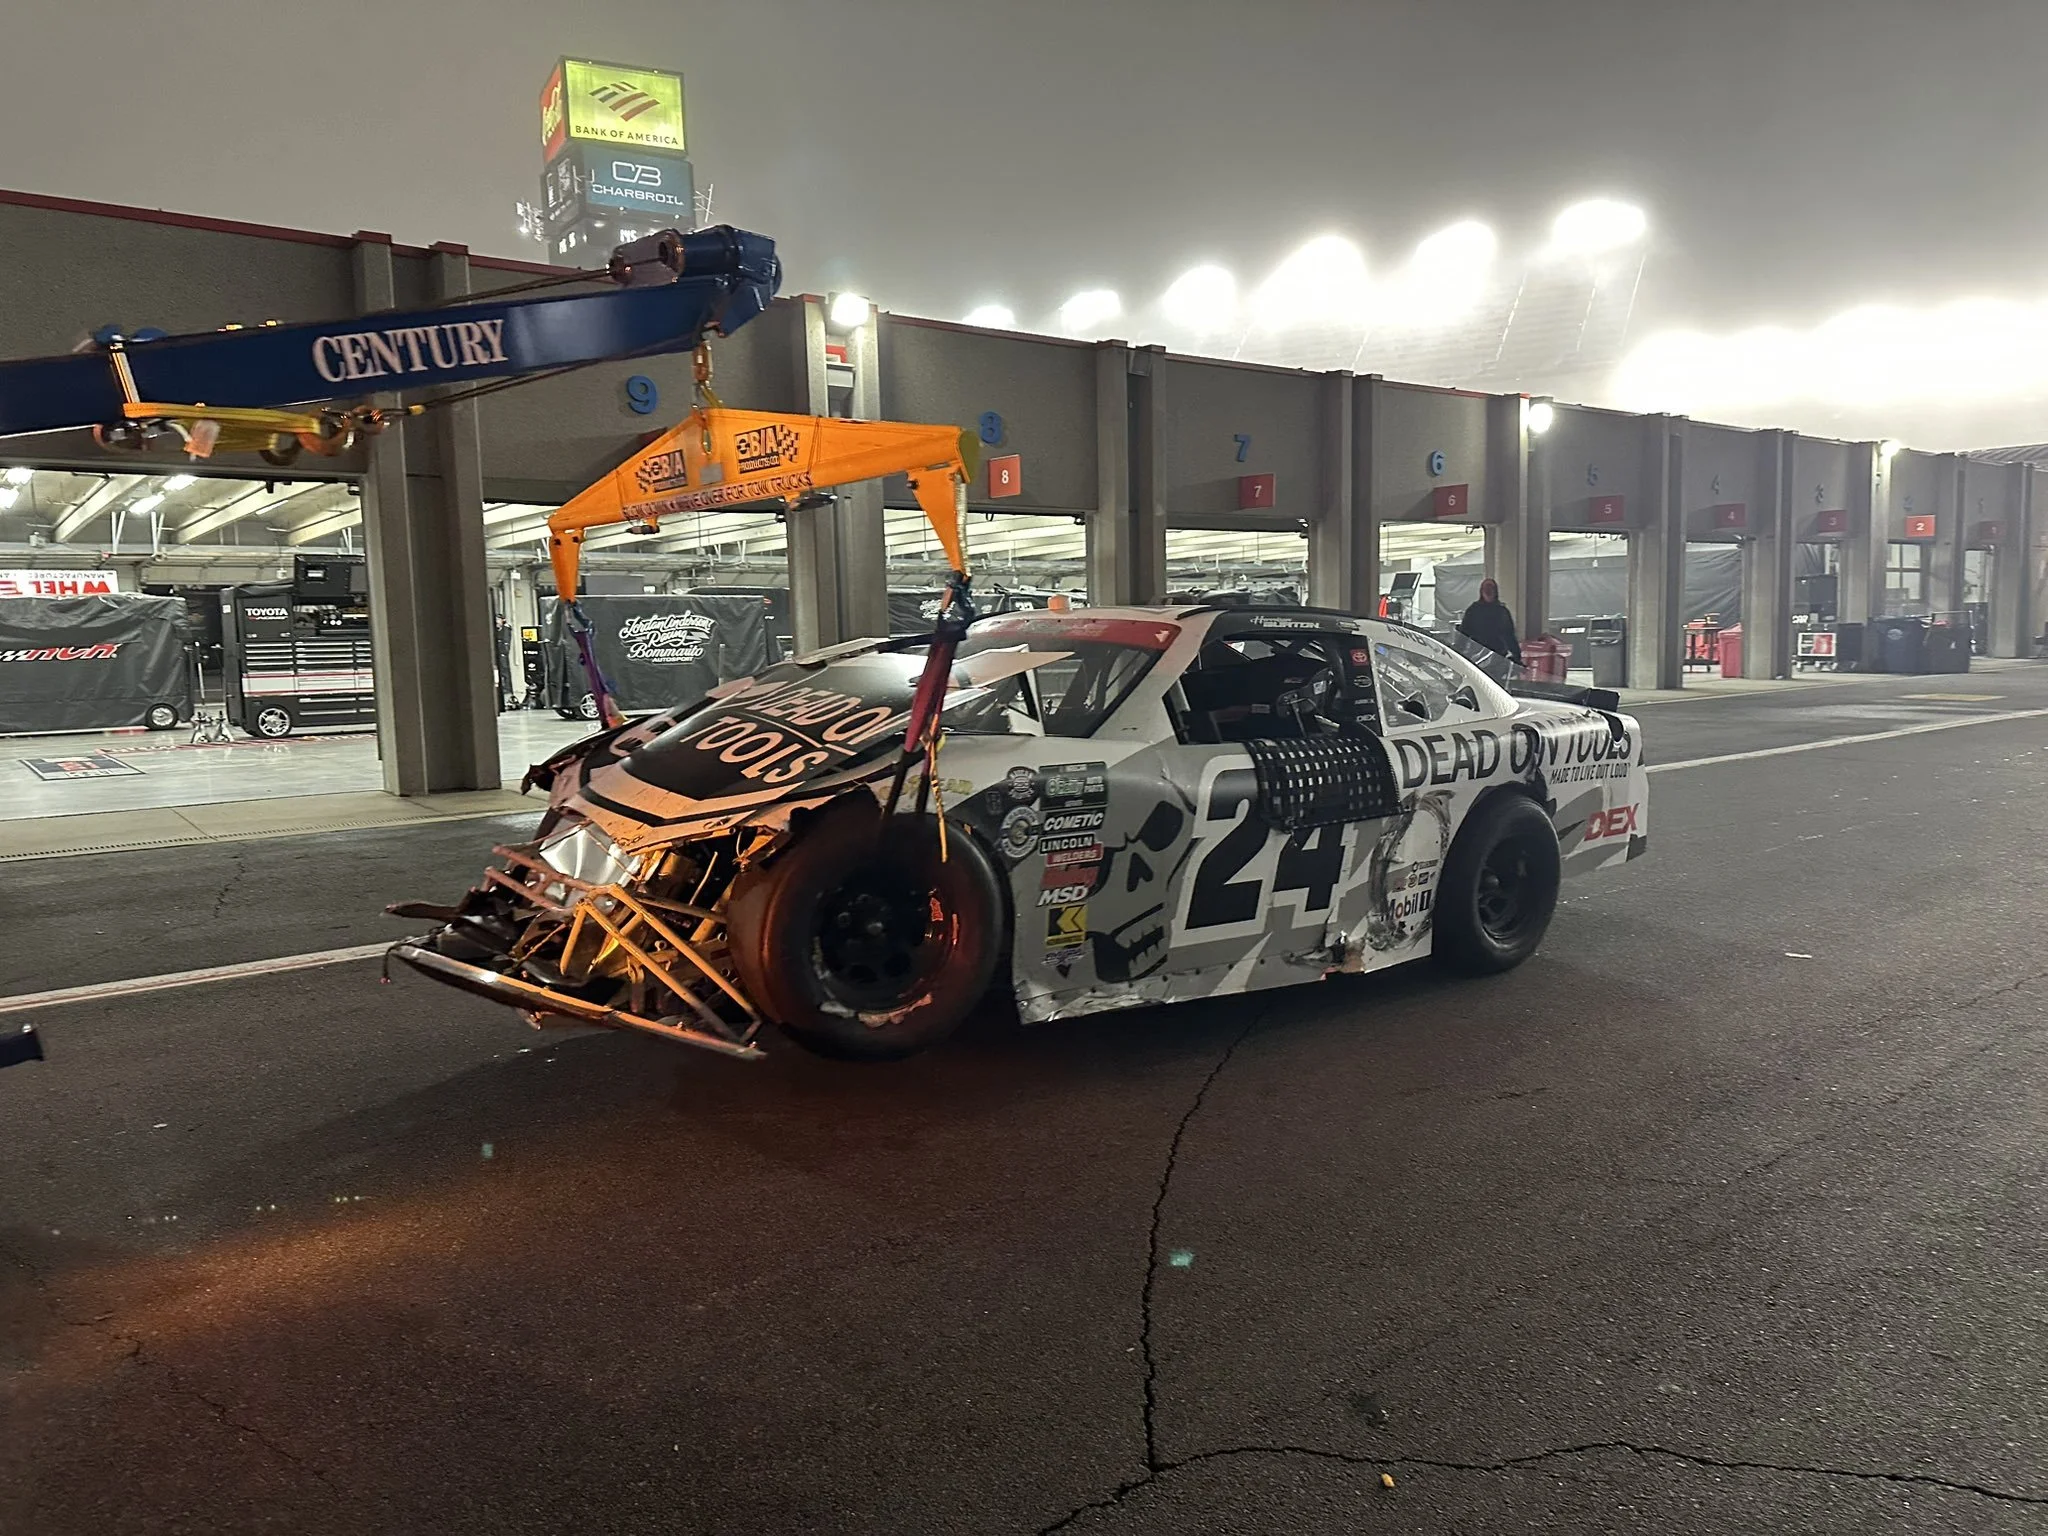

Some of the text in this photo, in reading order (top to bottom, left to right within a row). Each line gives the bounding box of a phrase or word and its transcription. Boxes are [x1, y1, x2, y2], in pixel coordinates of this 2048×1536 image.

[575, 125, 679, 145] BANK OF AMERICA
[612, 160, 662, 187] CB
[592, 184, 684, 206] CHARBROIL
[312, 319, 509, 382] CENTURY
[626, 375, 657, 414] 9
[978, 411, 1003, 444] 8
[1234, 432, 1251, 462] 7
[1430, 449, 1446, 476] 6
[1001, 469, 1010, 484] 8
[700, 488, 725, 507] OVER
[726, 484, 746, 502] FOR
[747, 480, 769, 498] TOW
[770, 470, 814, 492] TRUCKS
[1254, 485, 1262, 498] 7
[1448, 494, 1457, 506] 6
[1603, 503, 1612, 514] 5
[1728, 511, 1736, 520] 4
[1828, 517, 1837, 526] 3
[1916, 522, 1925, 531] 2
[245, 607, 289, 616] TOYOTA
[619, 610, 716, 639] Jordan Anderson
[1263, 620, 1321, 630] BURTON
[627, 642, 704, 658] Bommarito
[646, 630, 692, 648] Racing
[745, 687, 862, 726] DEAD
[679, 715, 830, 784] TOOLS
[1392, 729, 1501, 789] DEAD
[1549, 767, 1569, 785] MADE
[1569, 766, 1578, 783] TO
[1577, 765, 1595, 782] LIVE
[1595, 763, 1609, 780] OUT
[1043, 812, 1104, 832] COMETIC
[1583, 803, 1639, 841] DEX
[1041, 836, 1093, 852] LINCOLN
[1178, 762, 1350, 938] 24
[1052, 850, 1098, 863] WELDERS
[1037, 885, 1088, 907] MSD
